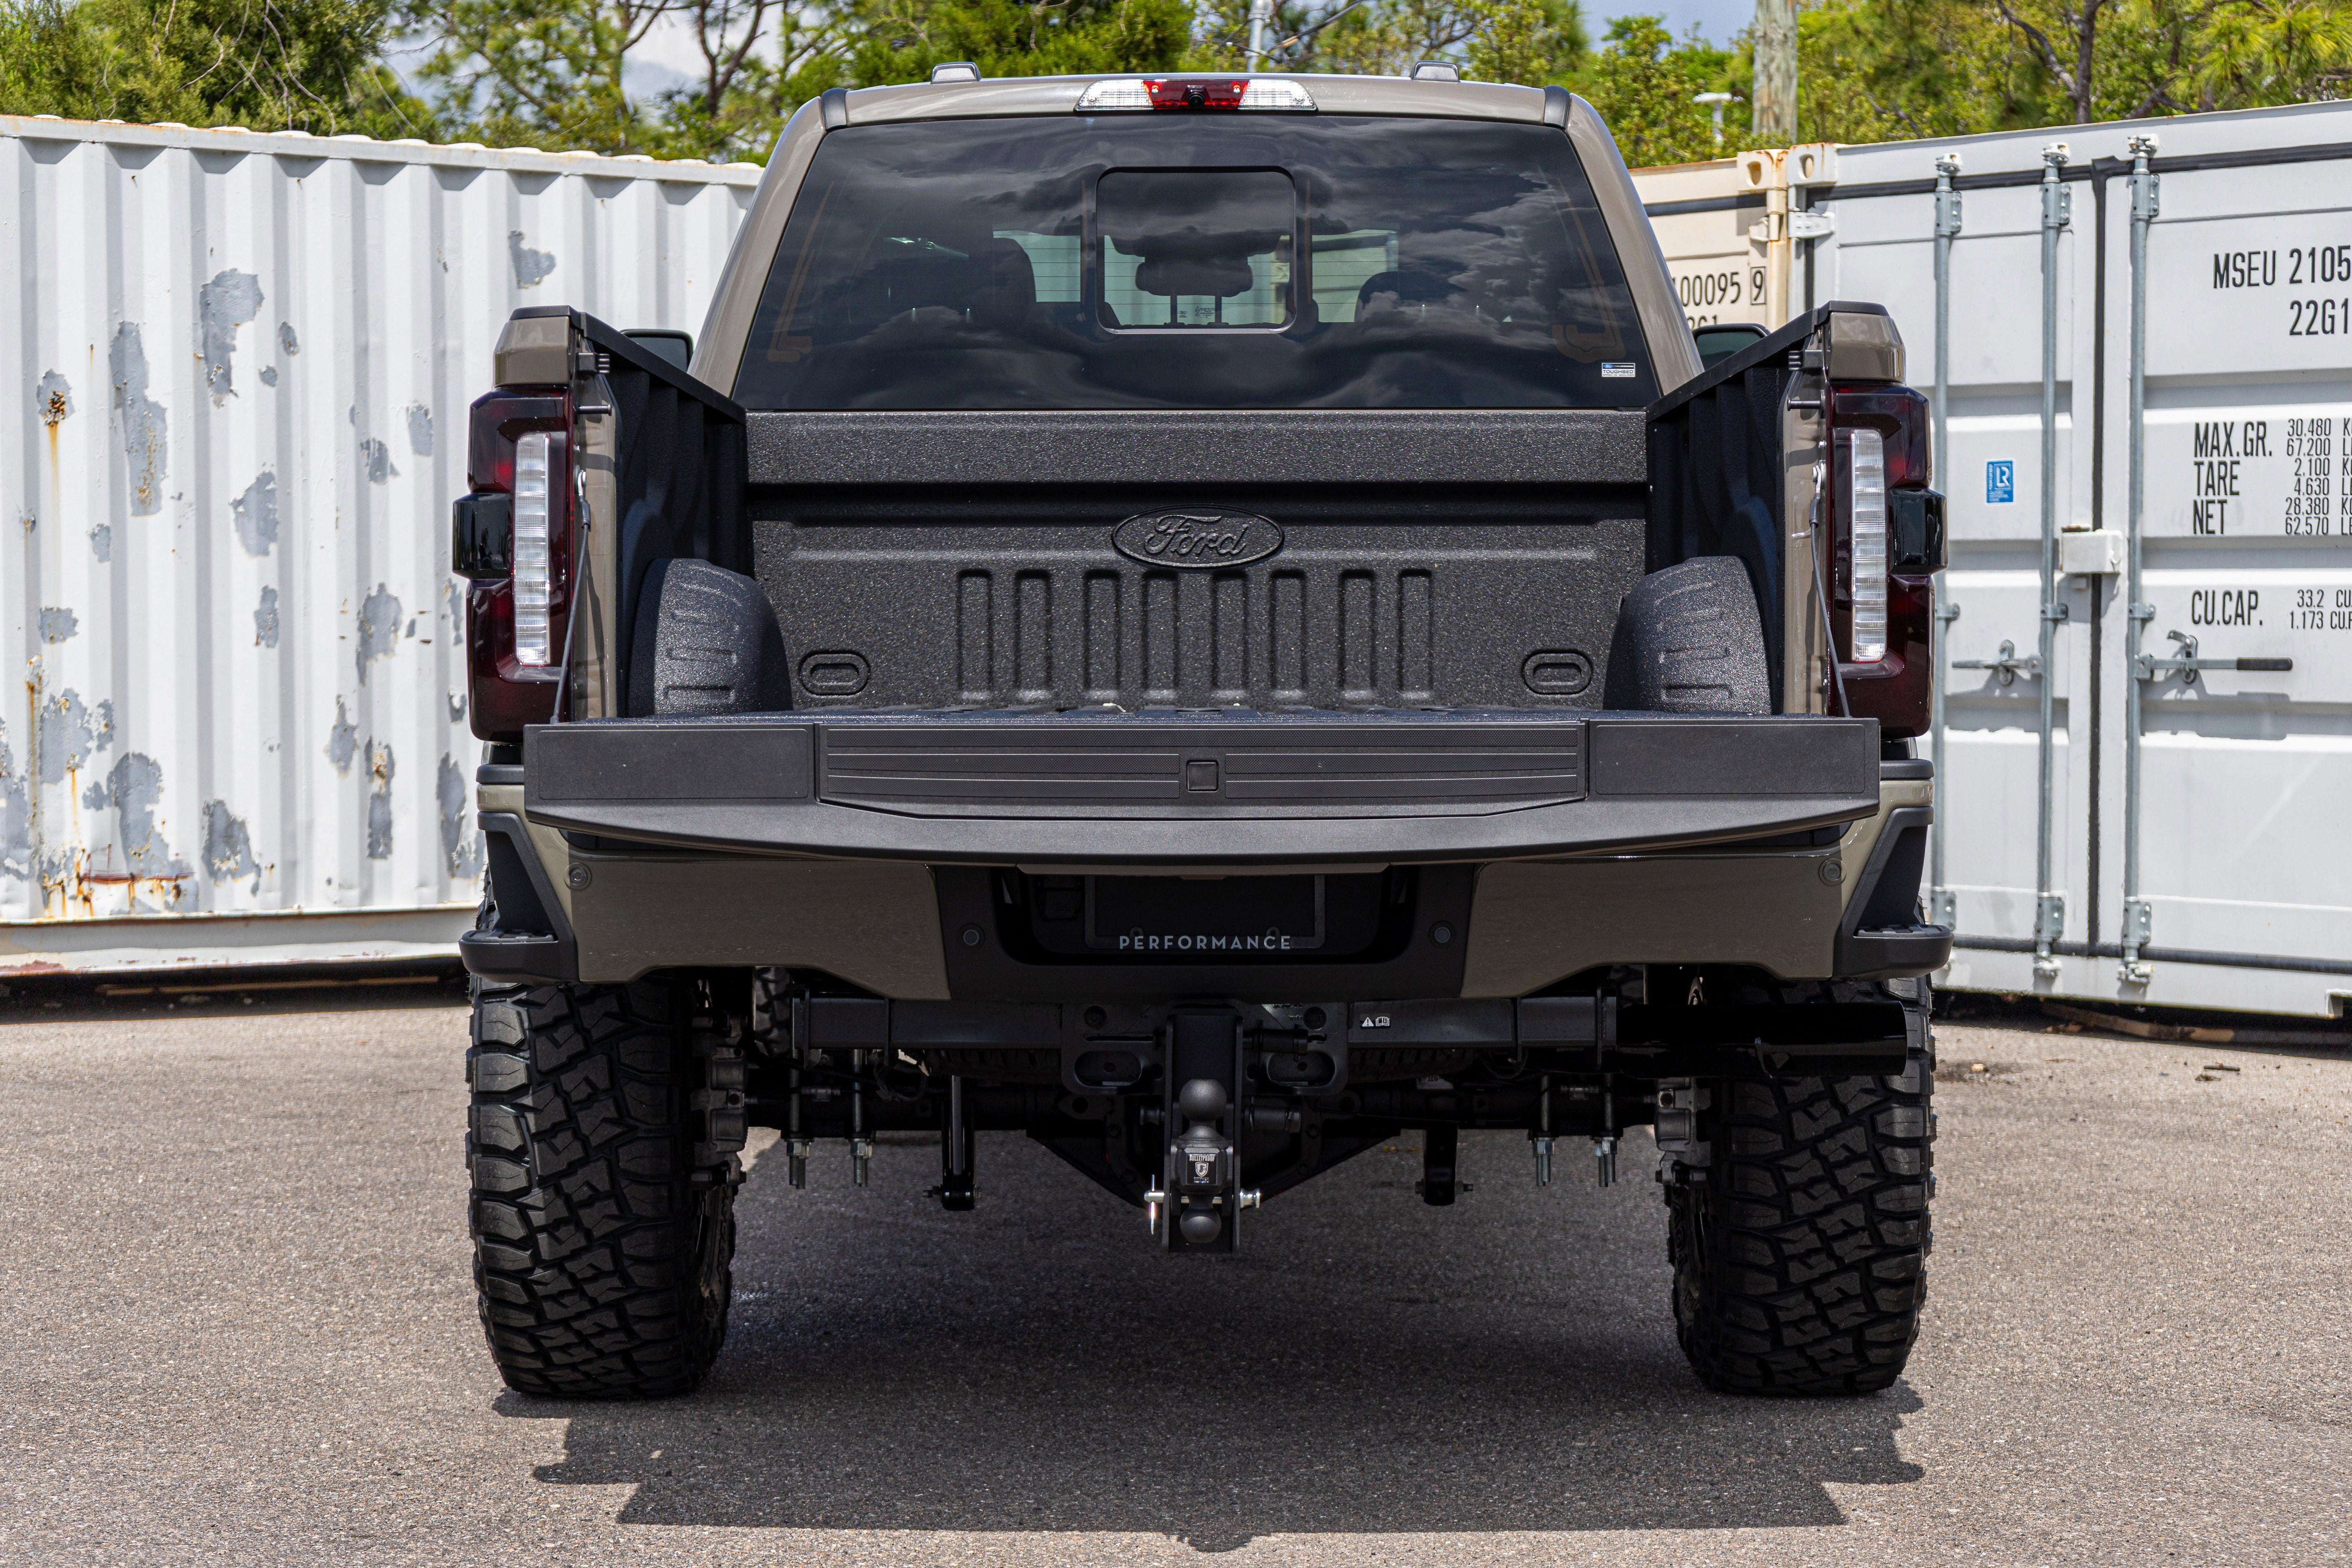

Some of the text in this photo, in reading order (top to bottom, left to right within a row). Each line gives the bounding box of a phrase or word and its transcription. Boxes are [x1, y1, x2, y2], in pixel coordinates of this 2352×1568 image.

[2213, 245, 2351, 289] MSEU 2105
[1672, 269, 1764, 307] 00095 9
[2289, 297, 2349, 336] 22G1
[2194, 421, 2272, 457] MAX.GR.
[2343, 417, 2352, 436] K
[2194, 460, 2241, 496] TARE
[2342, 457, 2352, 476] K
[1143, 514, 1249, 555] Ford
[2193, 499, 2227, 535] NET
[1119, 935, 1290, 950] PERFORMANCE
